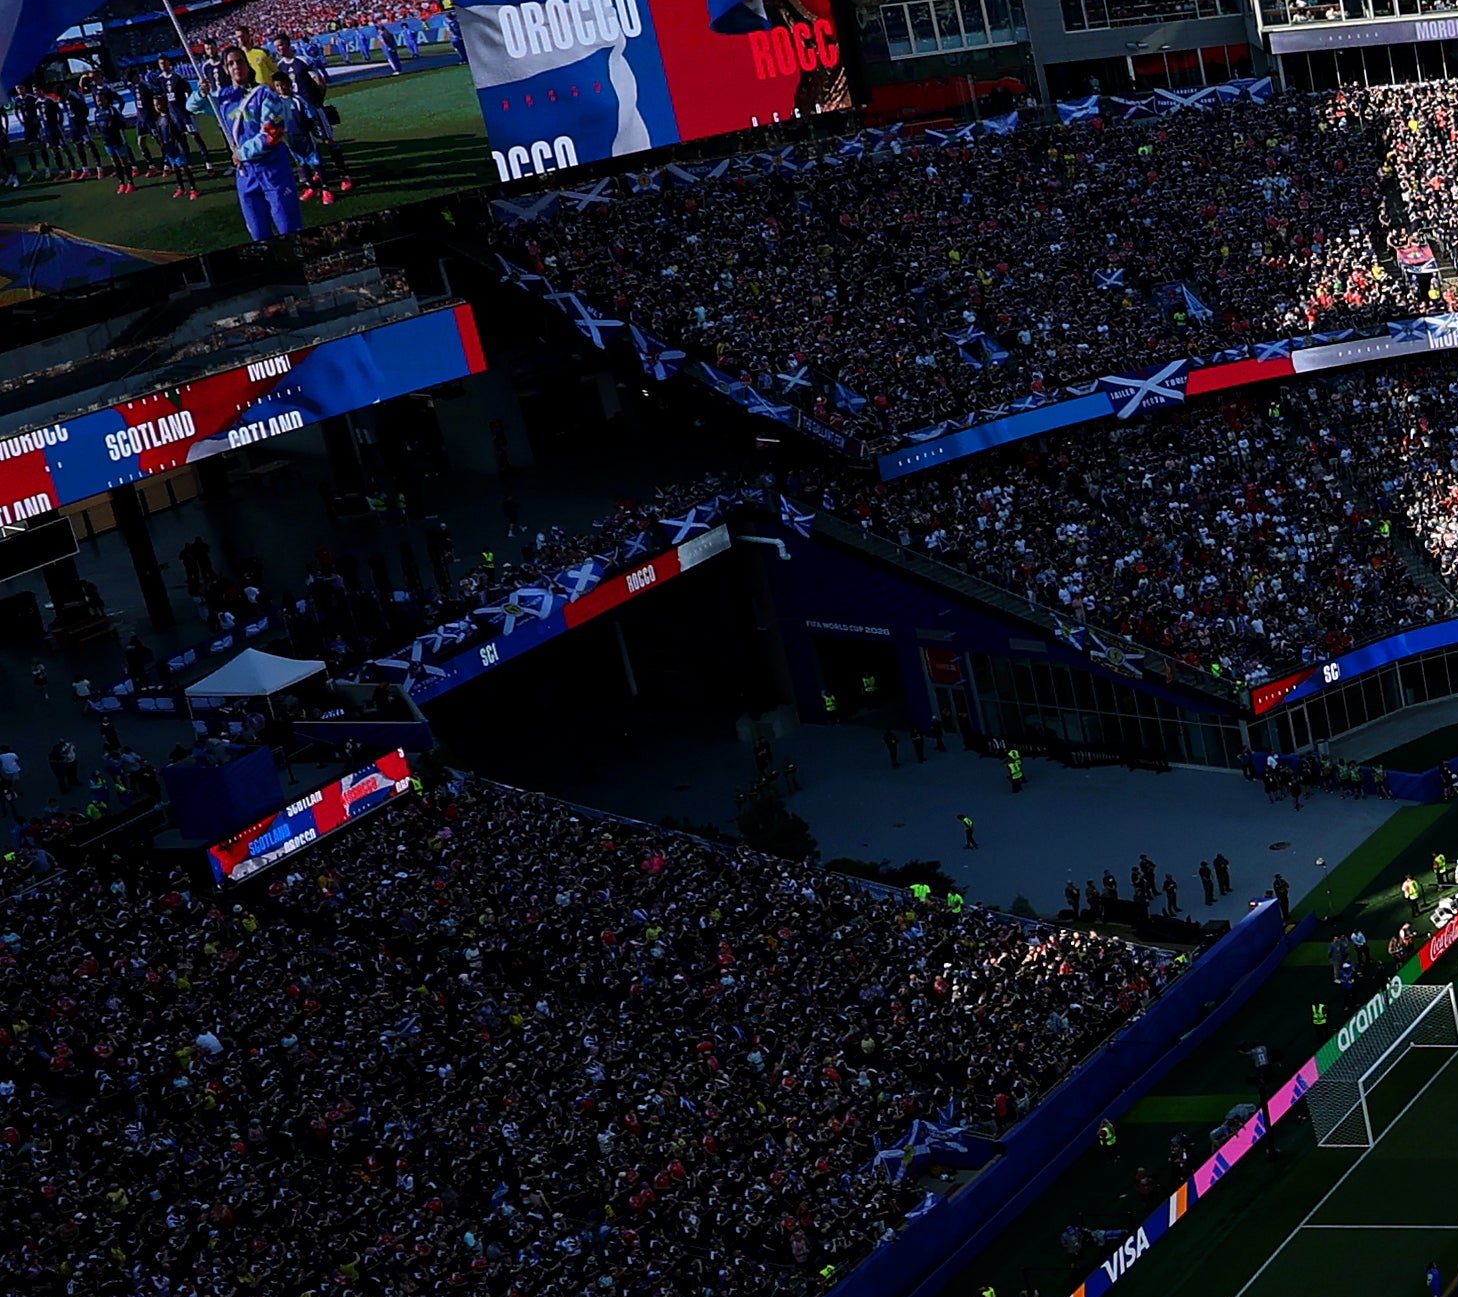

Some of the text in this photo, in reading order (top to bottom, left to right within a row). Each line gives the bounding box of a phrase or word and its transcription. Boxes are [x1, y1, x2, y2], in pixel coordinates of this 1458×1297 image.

[748, 17, 839, 81] ROCC
[105, 409, 196, 462] SCOTLAND
[822, 621, 848, 631] WORLD
[849, 624, 864, 632] CUP
[248, 823, 291, 857] SCOTLAND
[1101, 1226, 1150, 1284] VISA
